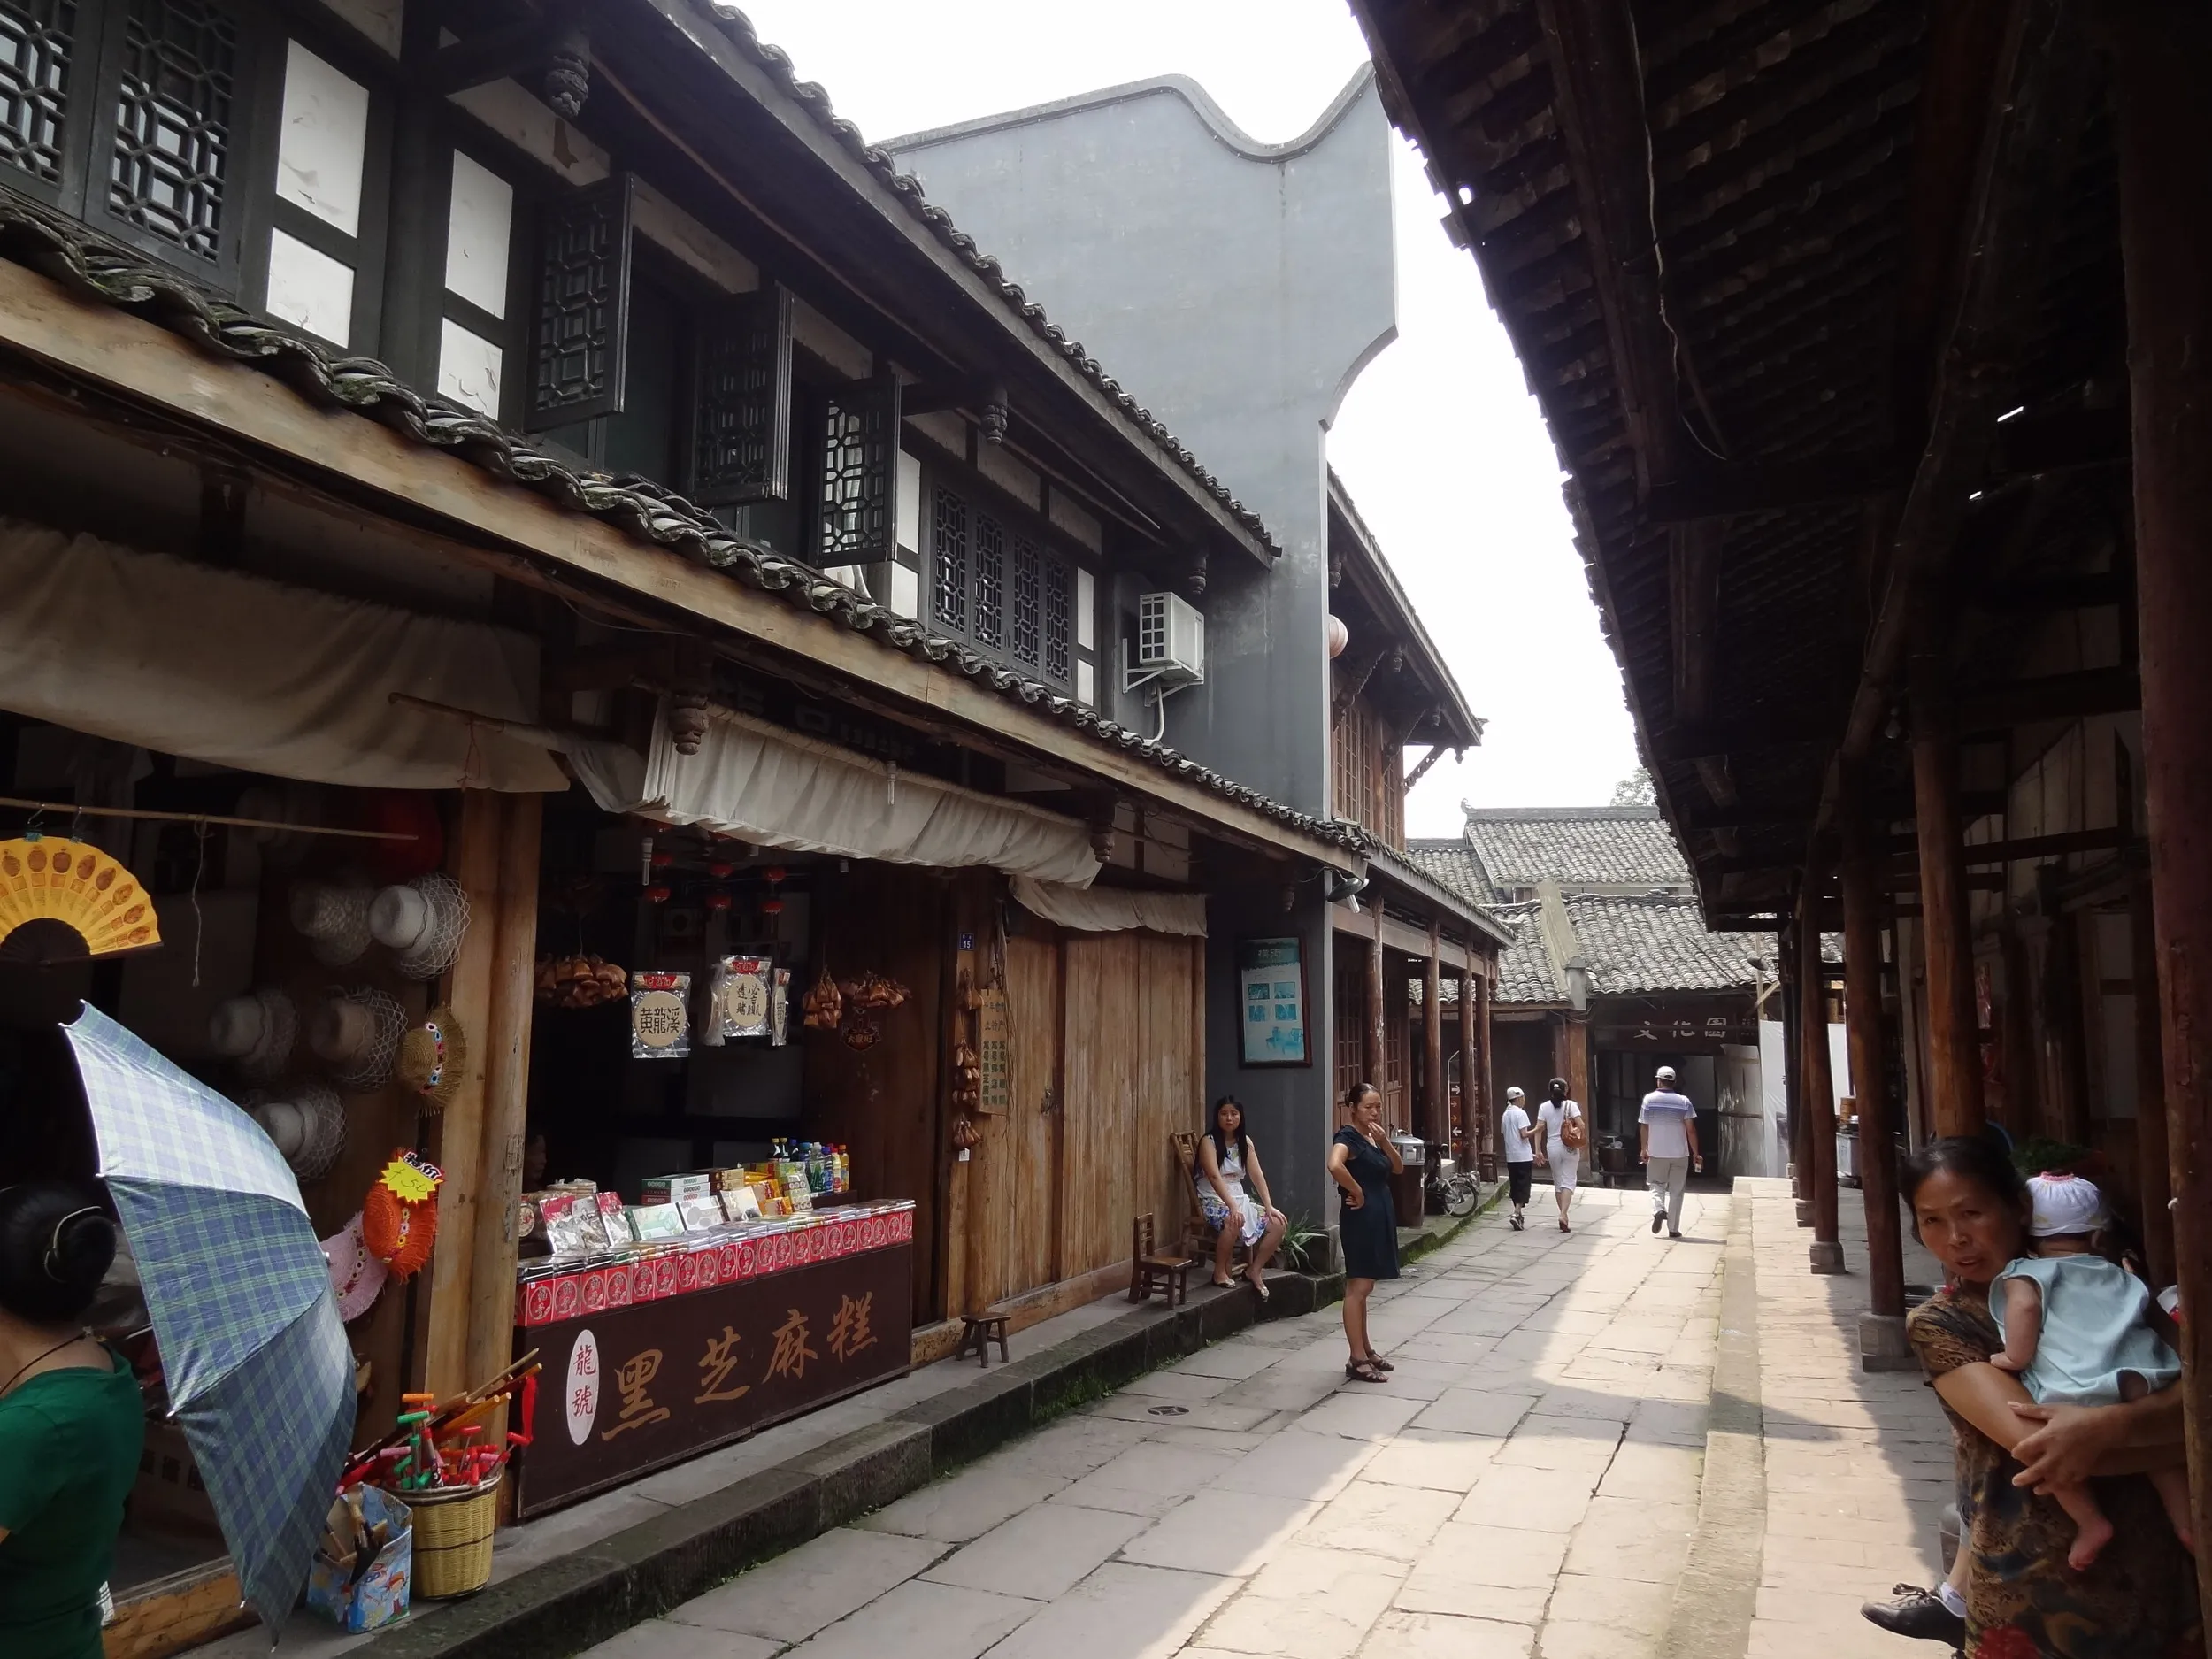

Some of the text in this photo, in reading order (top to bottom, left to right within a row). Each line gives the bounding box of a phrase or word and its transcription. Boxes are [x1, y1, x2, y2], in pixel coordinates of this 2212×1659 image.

[964, 940, 971, 949] 15
[572, 1344, 597, 1417] 龍號
[601, 1291, 878, 1441] 黑芝麻糕
